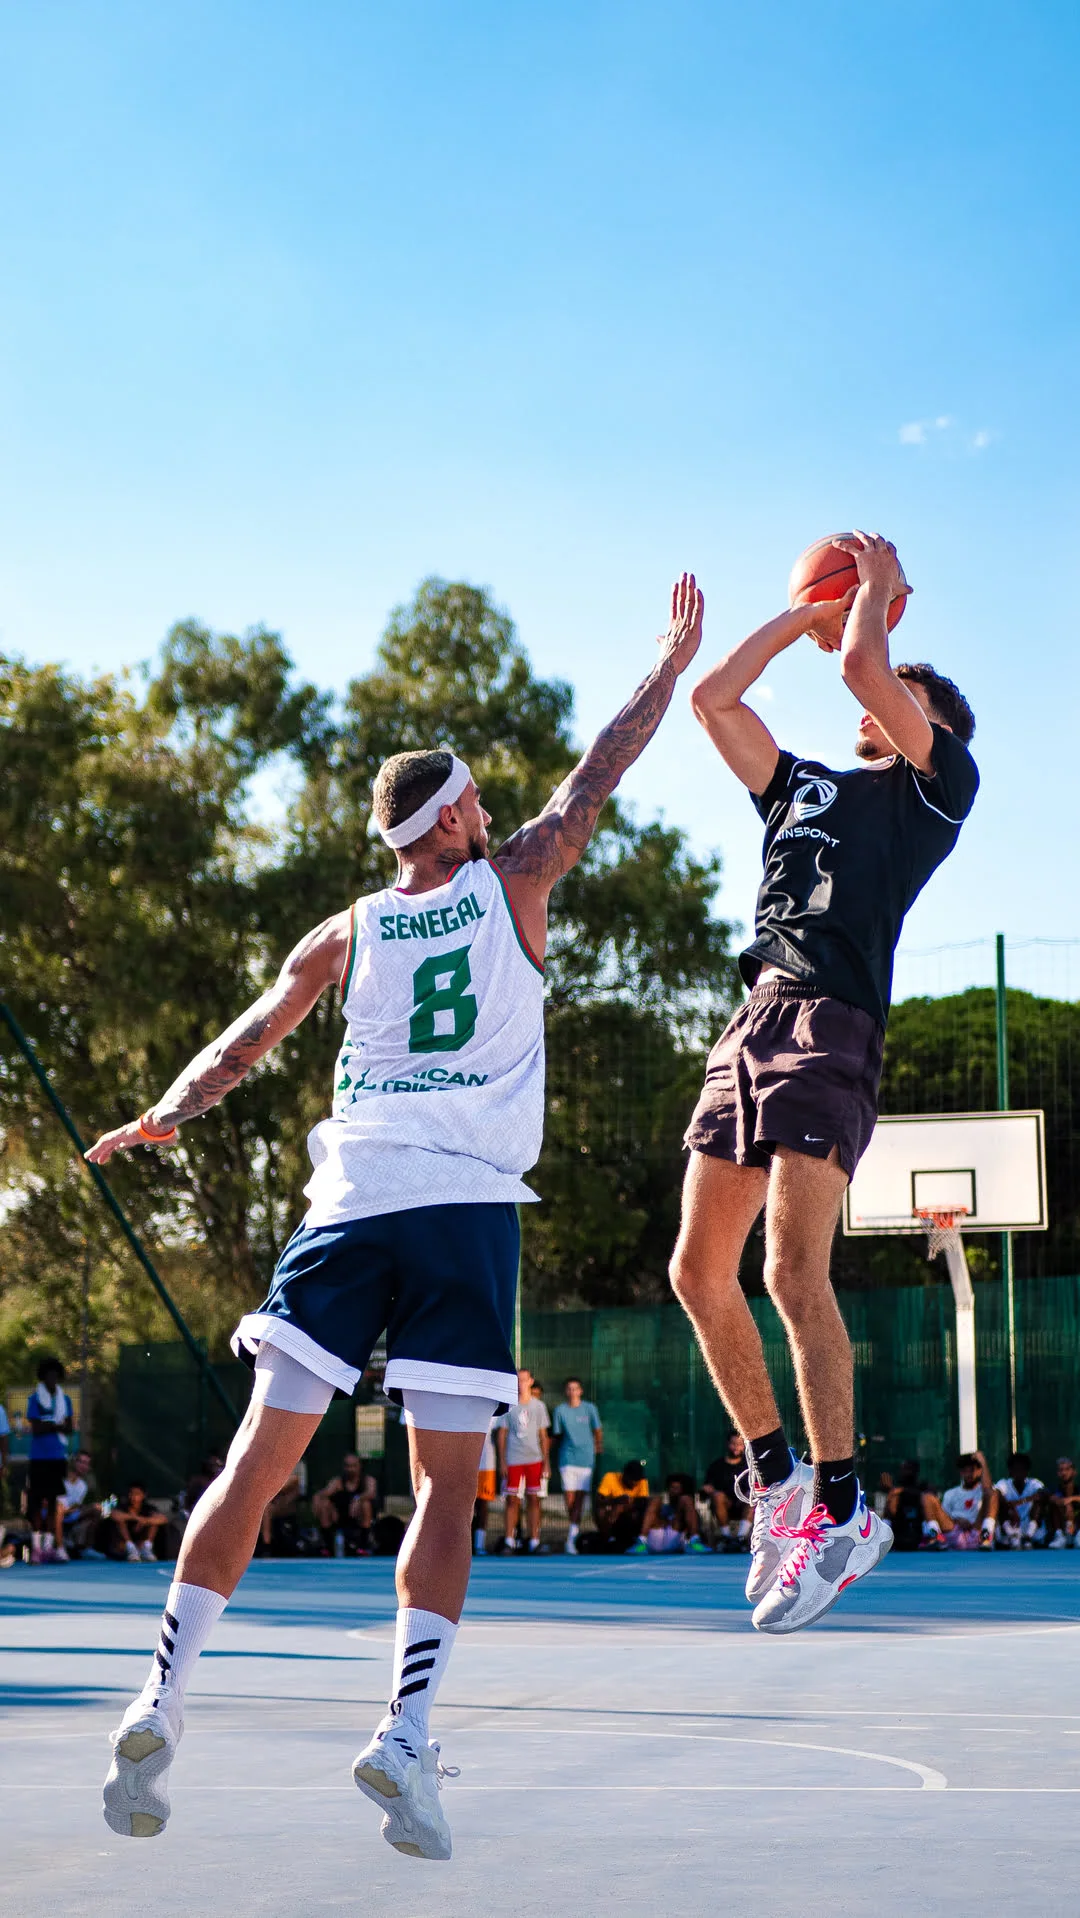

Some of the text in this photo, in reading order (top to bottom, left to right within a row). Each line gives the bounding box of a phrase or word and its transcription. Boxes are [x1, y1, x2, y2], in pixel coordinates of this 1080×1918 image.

[379, 892, 487, 941] SENEGAL
[408, 944, 479, 1054] 8
[412, 1067, 489, 1087] ICAN
